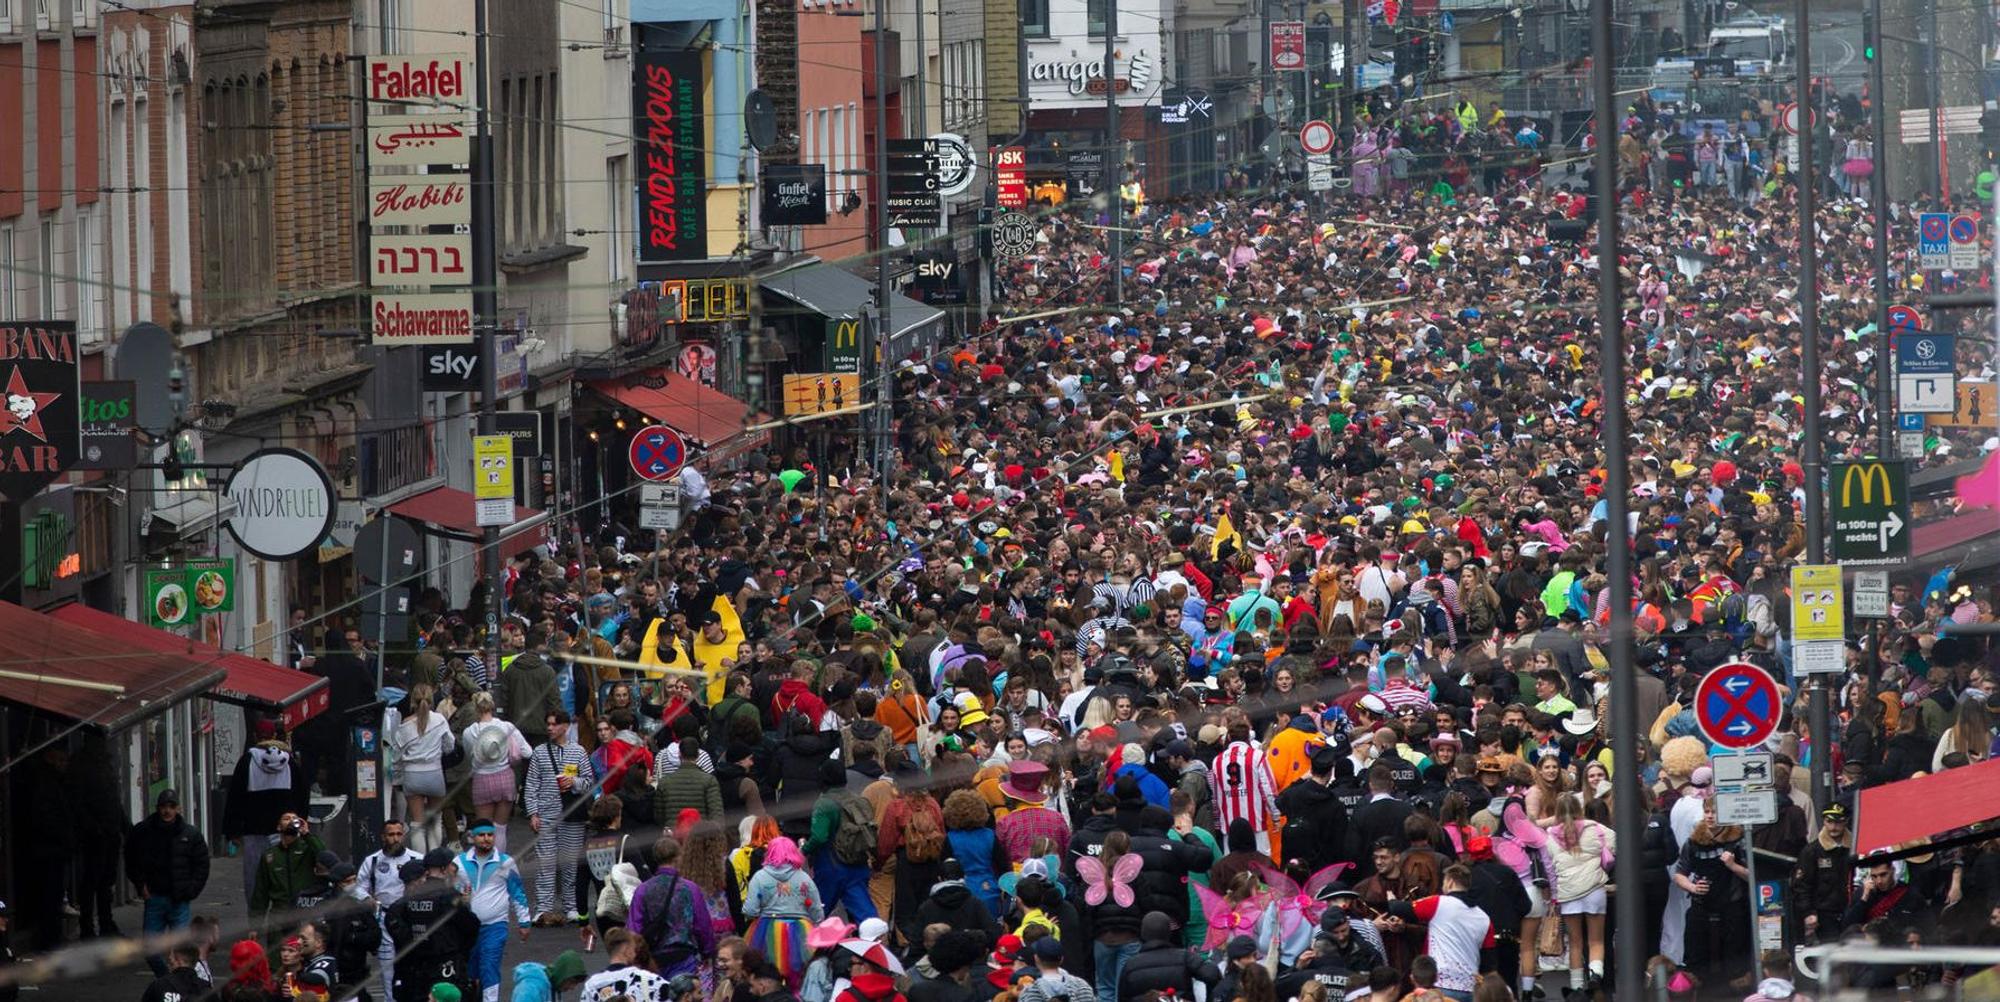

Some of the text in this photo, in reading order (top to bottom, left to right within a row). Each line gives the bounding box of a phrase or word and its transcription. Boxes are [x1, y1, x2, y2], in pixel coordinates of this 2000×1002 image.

[371, 60, 462, 101] Falafel
[375, 121, 463, 155] حبيبي
[645, 64, 678, 250] RENDEZVOUS
[682, 171, 697, 196] BAR
[374, 182, 465, 218] Habibi
[887, 198, 912, 206] MUSIC
[995, 213, 1033, 235] FRISEUR
[377, 246, 464, 274] ברכה
[1923, 243, 1947, 254] TAXI
[919, 259, 953, 280] sky
[375, 300, 471, 338] Schawarma
[429, 350, 478, 380] sky
[230, 488, 324, 518] WNDRFUEL
[1836, 521, 1847, 530] in
[1845, 533, 1878, 542] rechts
[1226, 761, 1242, 787] 9
[1390, 770, 1415, 780] OLIZEI
